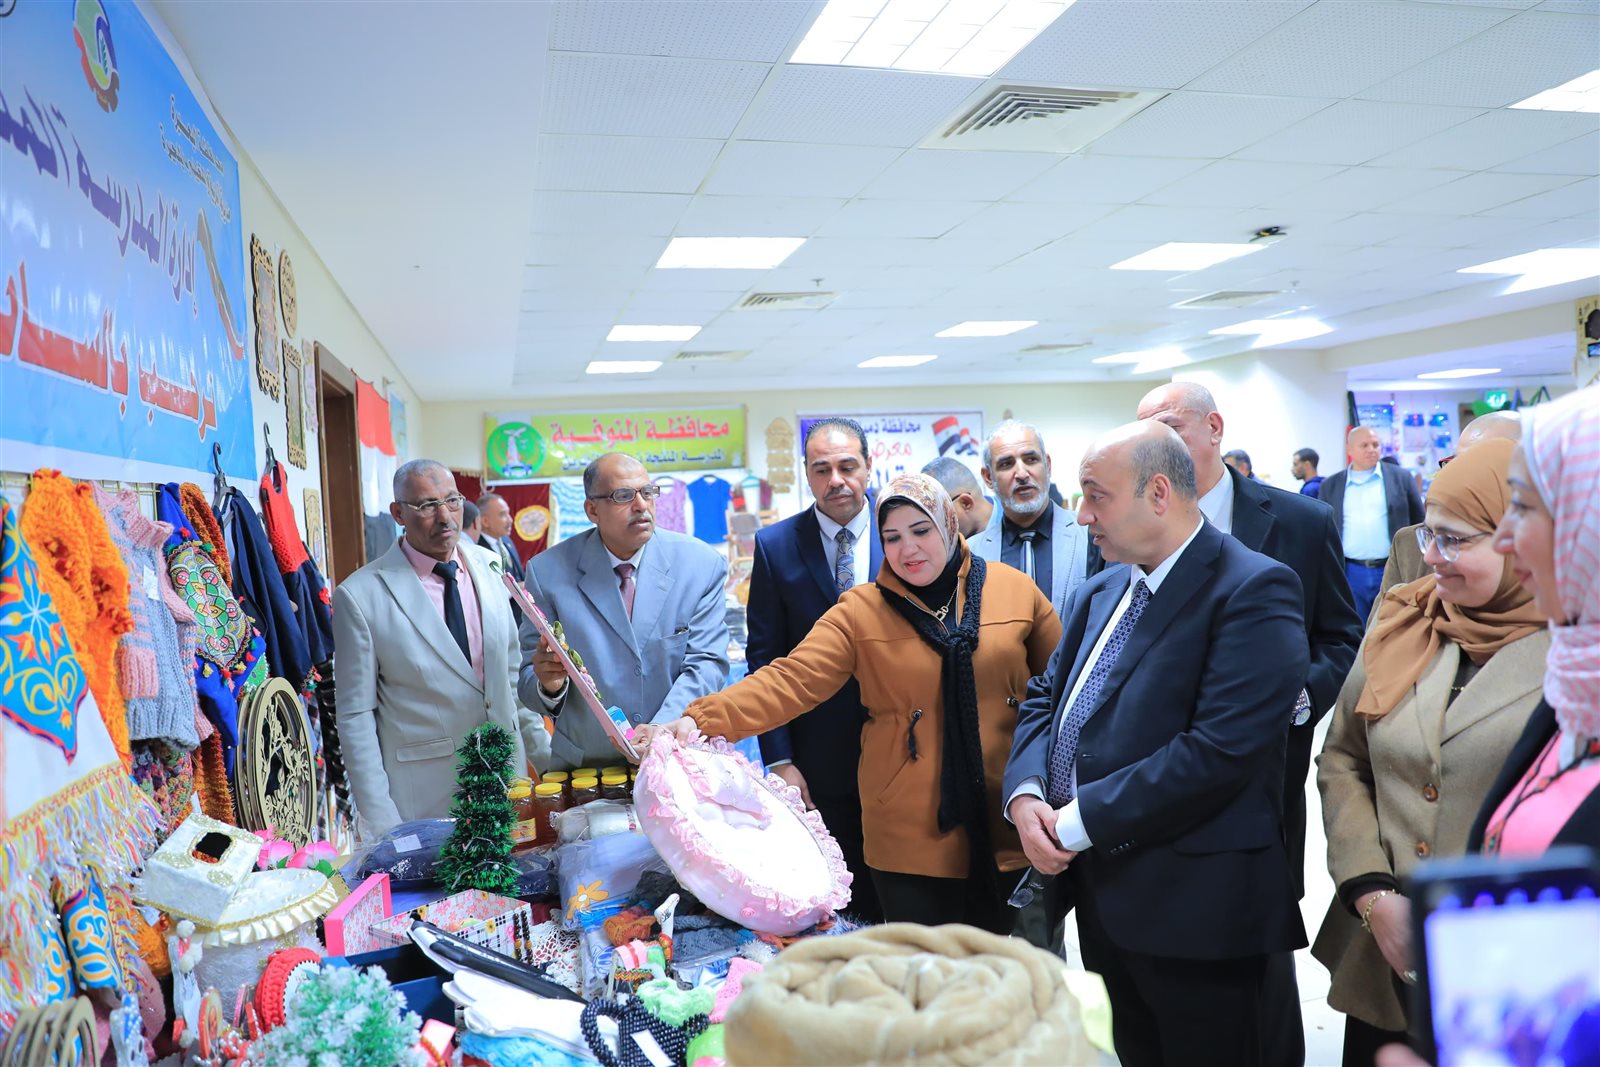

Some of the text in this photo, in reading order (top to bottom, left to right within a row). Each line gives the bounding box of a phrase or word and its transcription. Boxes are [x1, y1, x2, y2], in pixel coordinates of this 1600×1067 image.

[168, 200, 198, 320] إدارة
[0, 261, 218, 442] نرحب بالساد
[549, 415, 730, 450] محافظة المنوفية
[881, 417, 921, 433] محافظة
[870, 437, 913, 460] معرض
